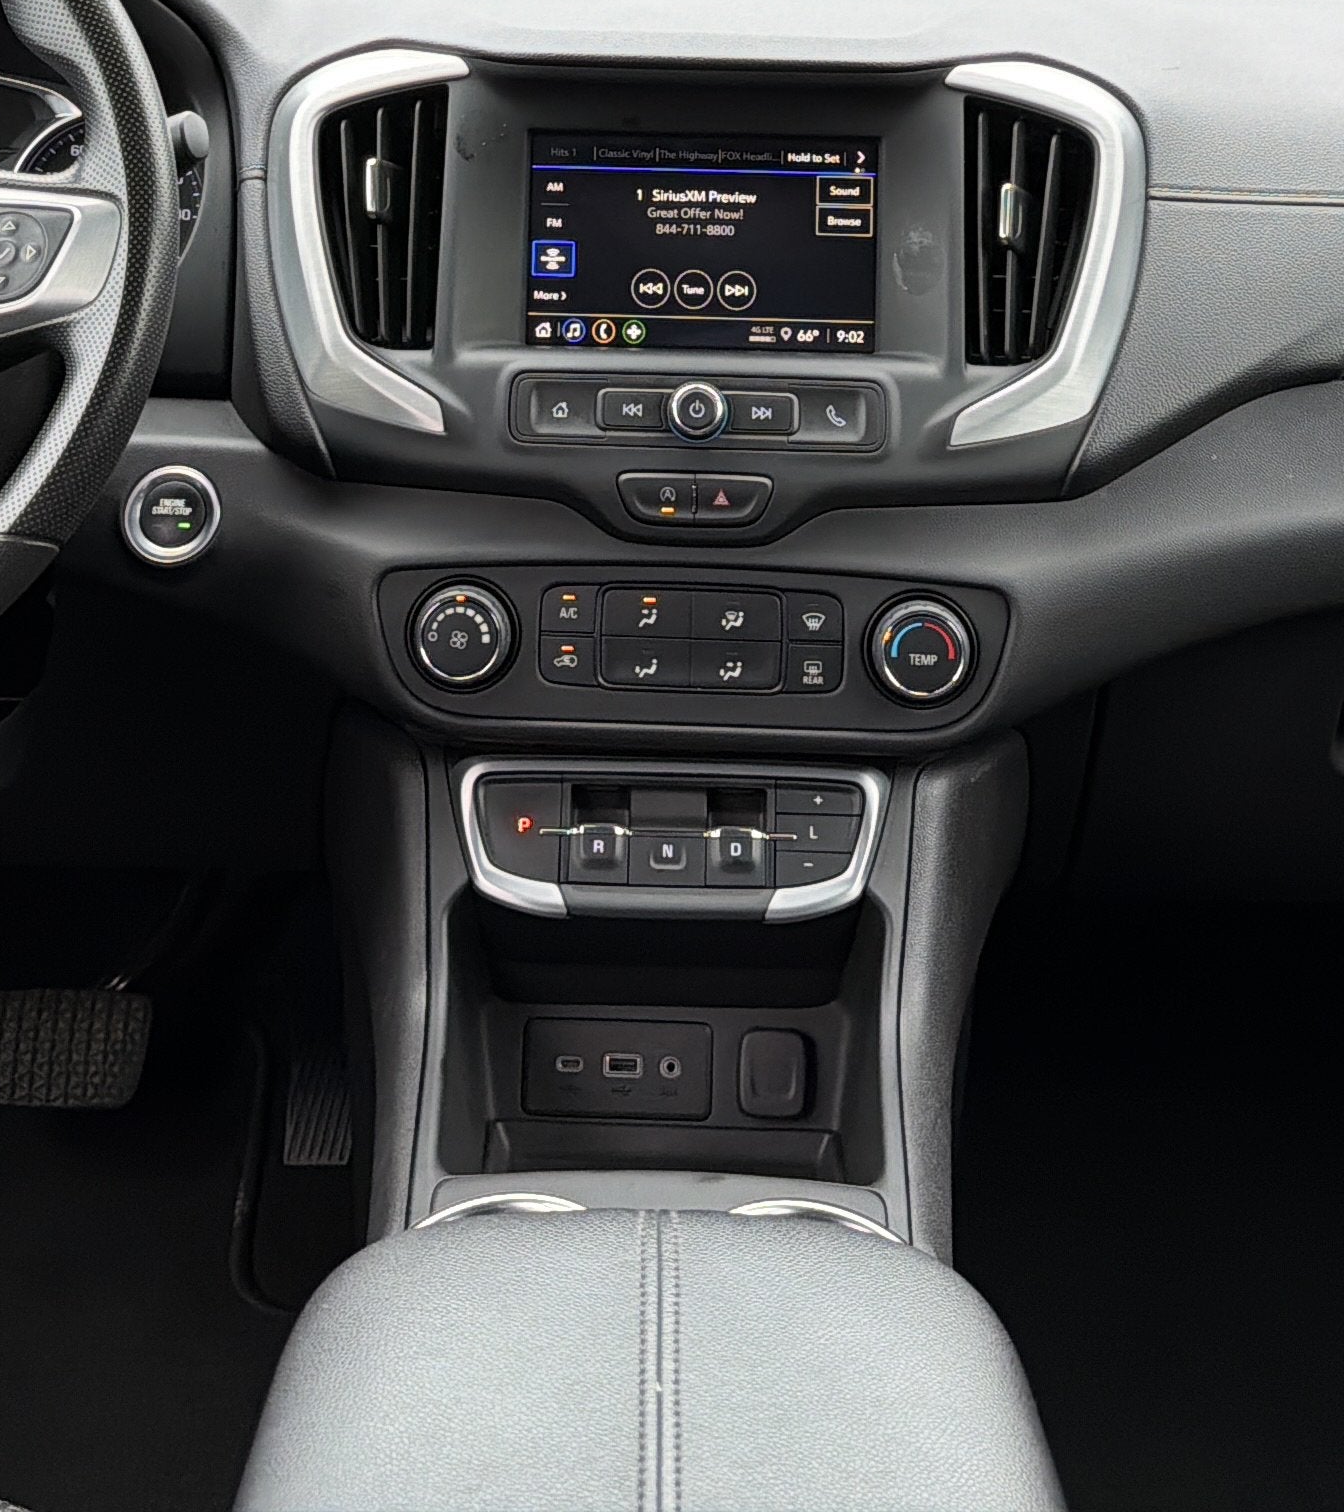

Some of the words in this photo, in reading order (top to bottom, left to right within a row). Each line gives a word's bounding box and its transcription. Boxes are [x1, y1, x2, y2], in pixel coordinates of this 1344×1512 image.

[550, 147, 569, 157] Hits
[598, 149, 630, 159] Classic
[632, 149, 654, 161] Vinyl
[660, 150, 676, 159] The
[679, 150, 718, 162] Highway
[722, 151, 741, 161] FOX
[787, 152, 810, 163] Hold
[812, 154, 823, 163] to
[824, 154, 840, 164] Set
[546, 182, 564, 192] AM
[829, 186, 860, 196] Sound
[636, 189, 643, 201] 1
[652, 189, 706, 202] SiriusXM
[708, 190, 757, 204] Preview
[647, 207, 678, 218] Great
[681, 207, 710, 219] Offer
[714, 208, 744, 220] Now!
[546, 217, 563, 228] FM
[827, 216, 862, 227] Browse
[655, 223, 735, 236] 844-711-8800
[533, 290, 559, 301] More
[681, 284, 705, 295] Tune
[762, 326, 774, 334] LTE
[836, 330, 865, 344] 9:02
[159, 498, 187, 507] ENGINE
[558, 605, 578, 620] A/C
[908, 653, 938, 667] TEMP
[802, 674, 824, 685] REAR
[517, 817, 534, 832] P
[810, 826, 819, 840] L
[593, 840, 605, 854] R
[662, 844, 674, 858] N
[731, 842, 742, 857] D
